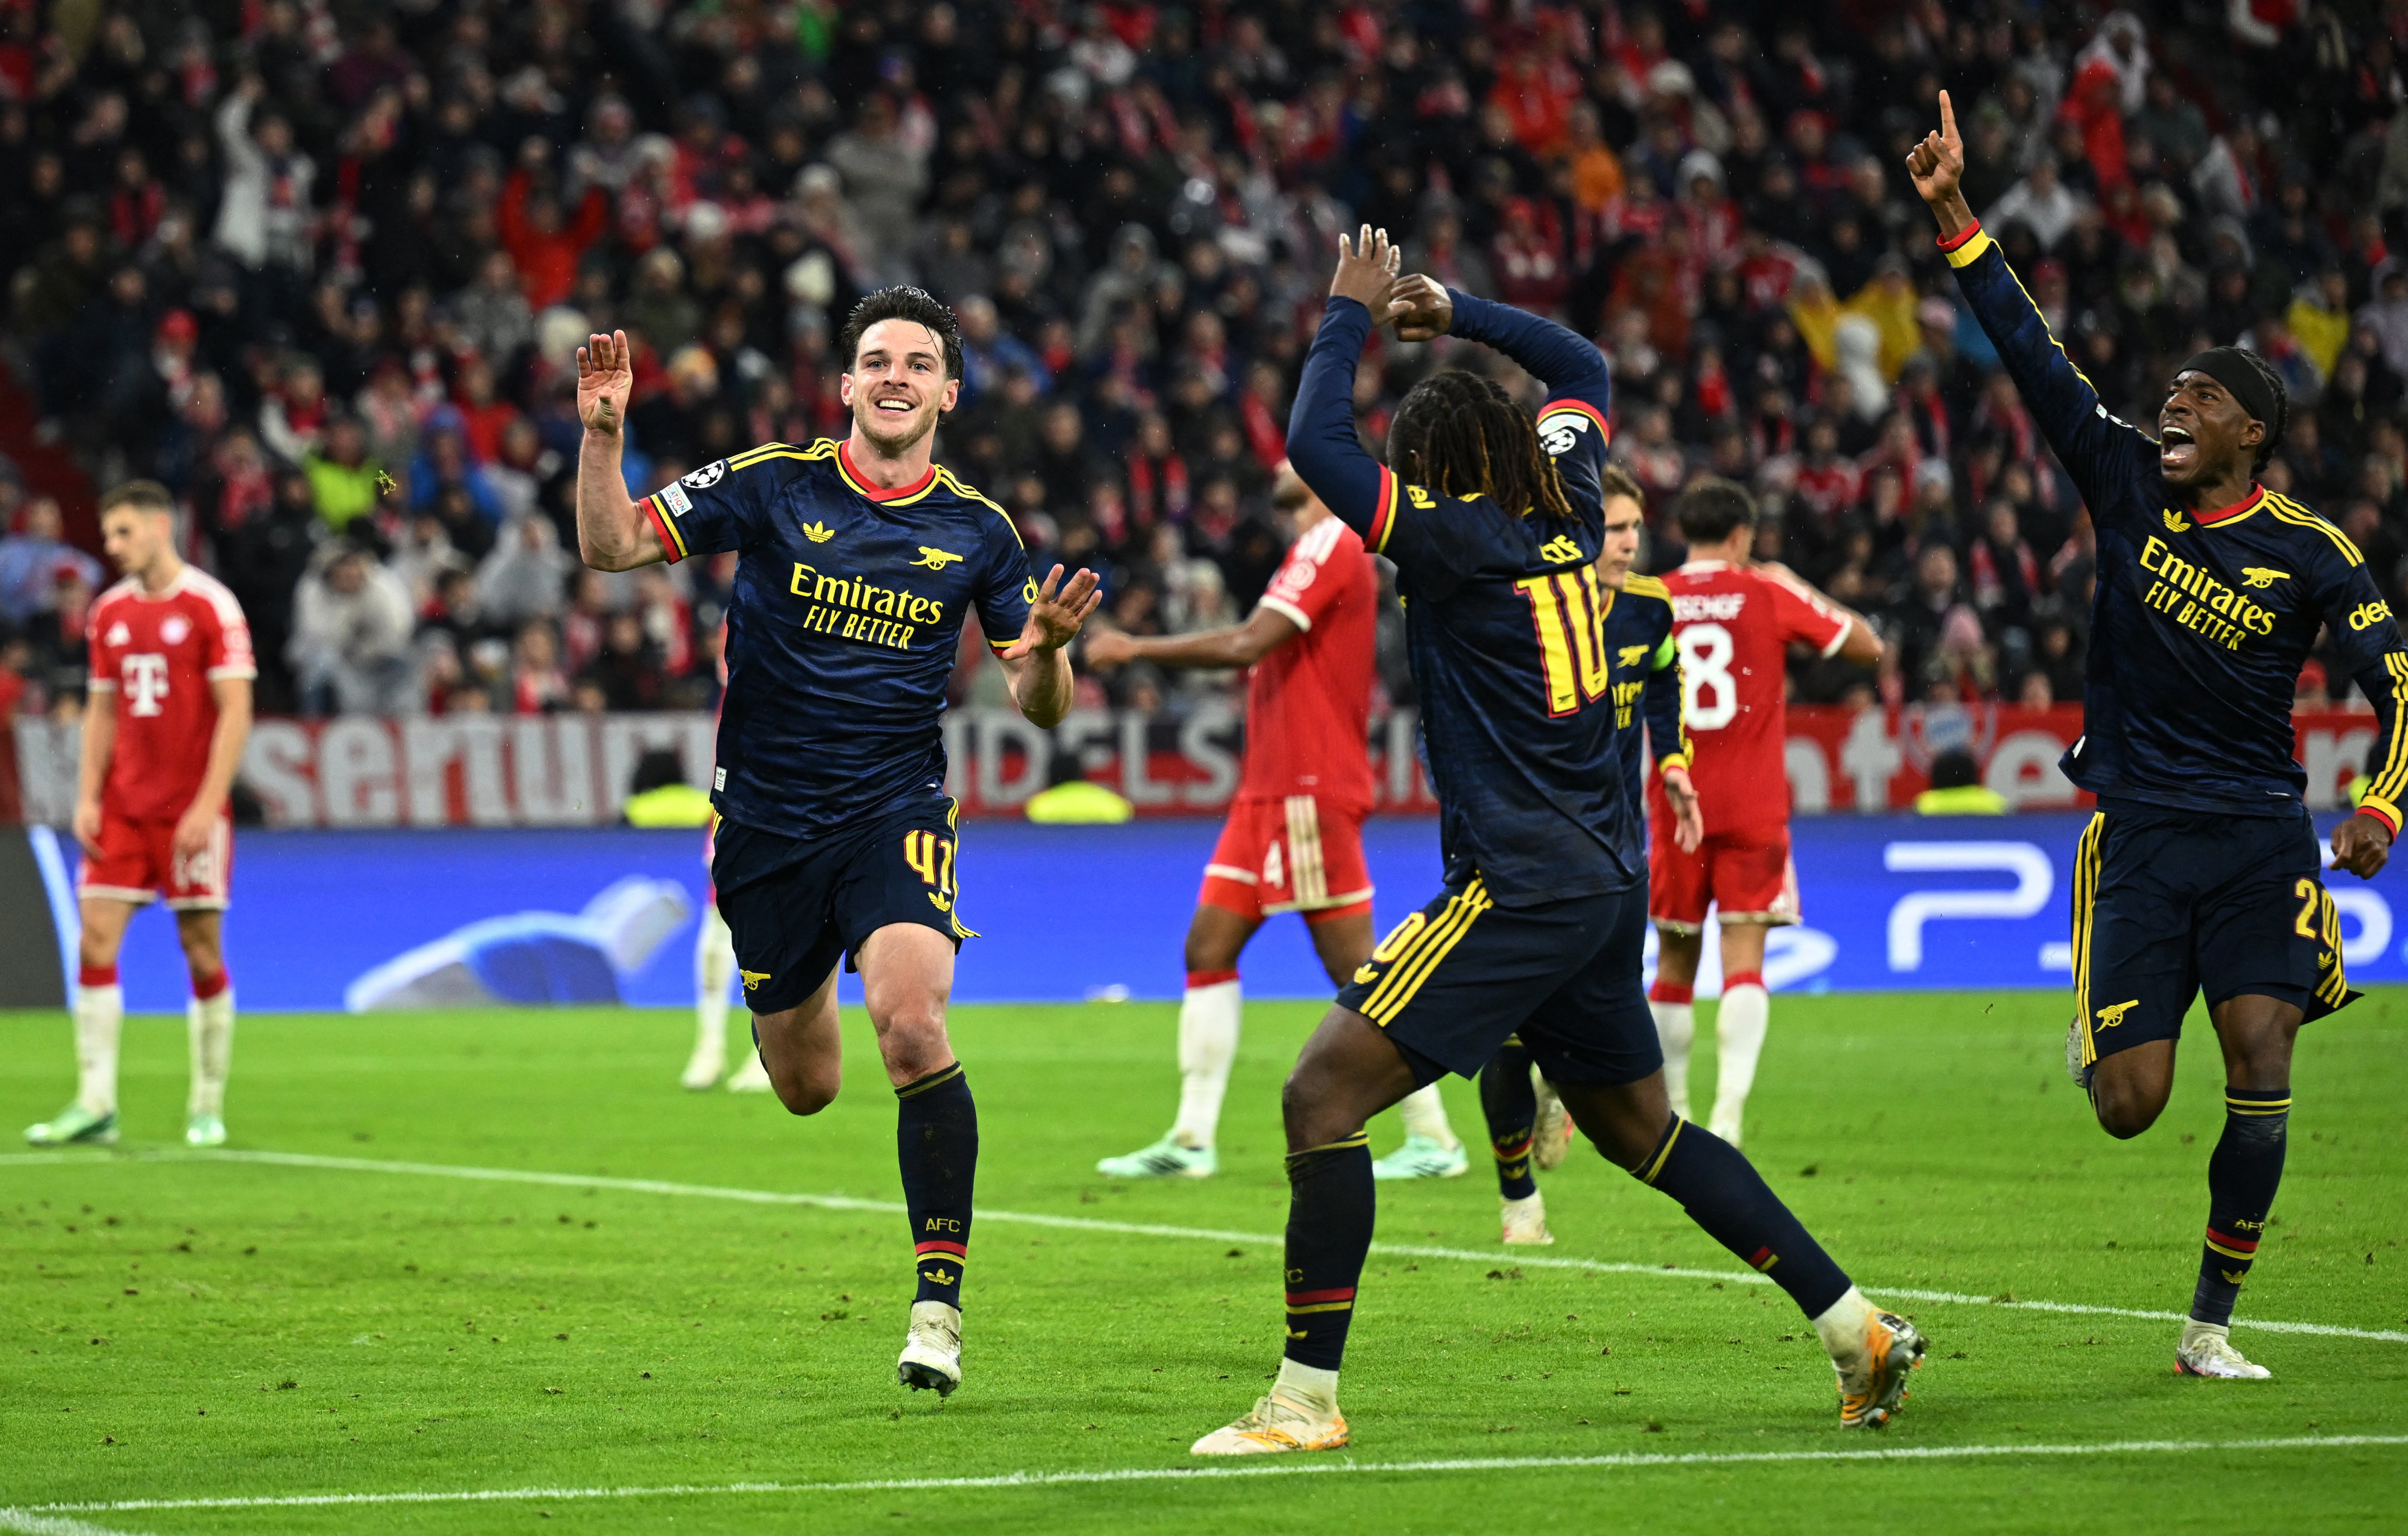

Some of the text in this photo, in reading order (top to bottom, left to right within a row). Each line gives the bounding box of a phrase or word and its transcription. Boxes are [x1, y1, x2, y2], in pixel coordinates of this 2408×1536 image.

[790, 562, 943, 625] Emirates
[2140, 535, 2276, 635] Emirates
[2144, 581, 2247, 651] FLY BETTER
[803, 605, 914, 649] FLY BETTER
[1512, 562, 1608, 718] 10
[1676, 622, 1737, 731] 8
[903, 829, 953, 896] 41
[1371, 911, 1427, 964] 0
[925, 1217, 960, 1233] AFC
